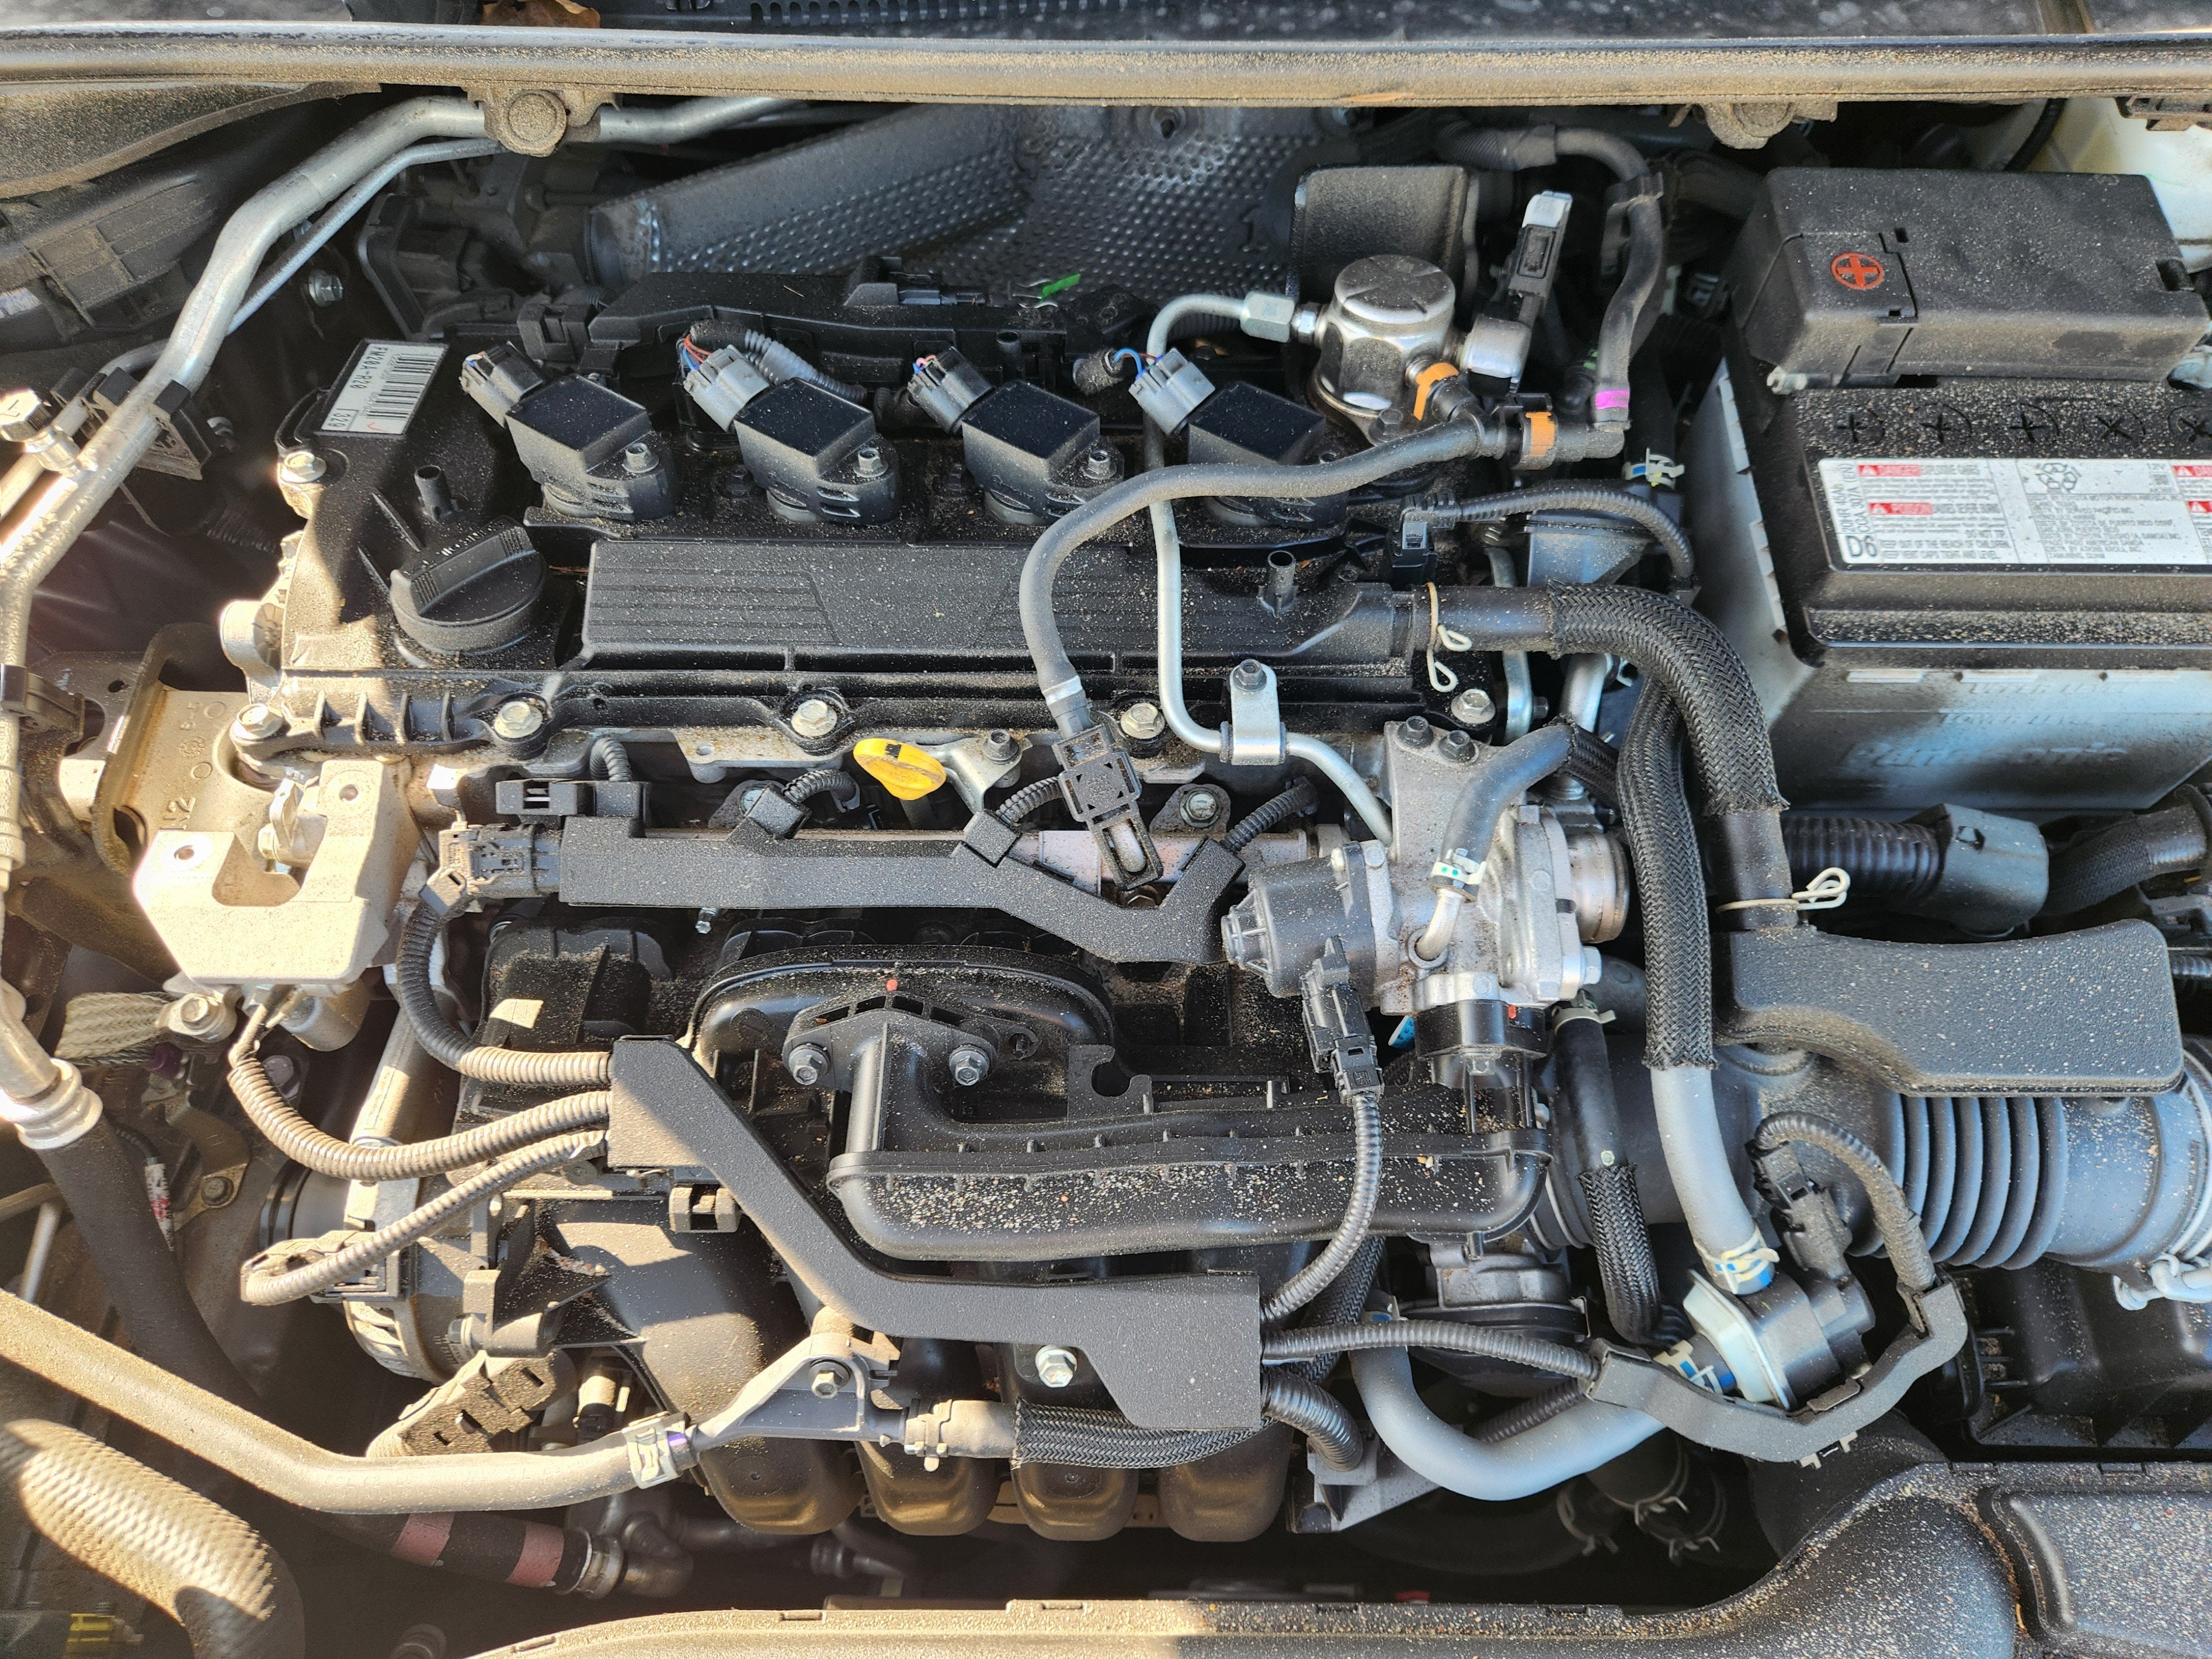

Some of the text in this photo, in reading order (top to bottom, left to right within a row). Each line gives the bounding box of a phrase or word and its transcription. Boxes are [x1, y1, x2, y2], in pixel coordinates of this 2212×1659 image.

[328, 413, 351, 427] 329
[1838, 507, 1853, 533] 20HR
[1855, 511, 1870, 533] CCA
[1847, 535, 1877, 557] D6
